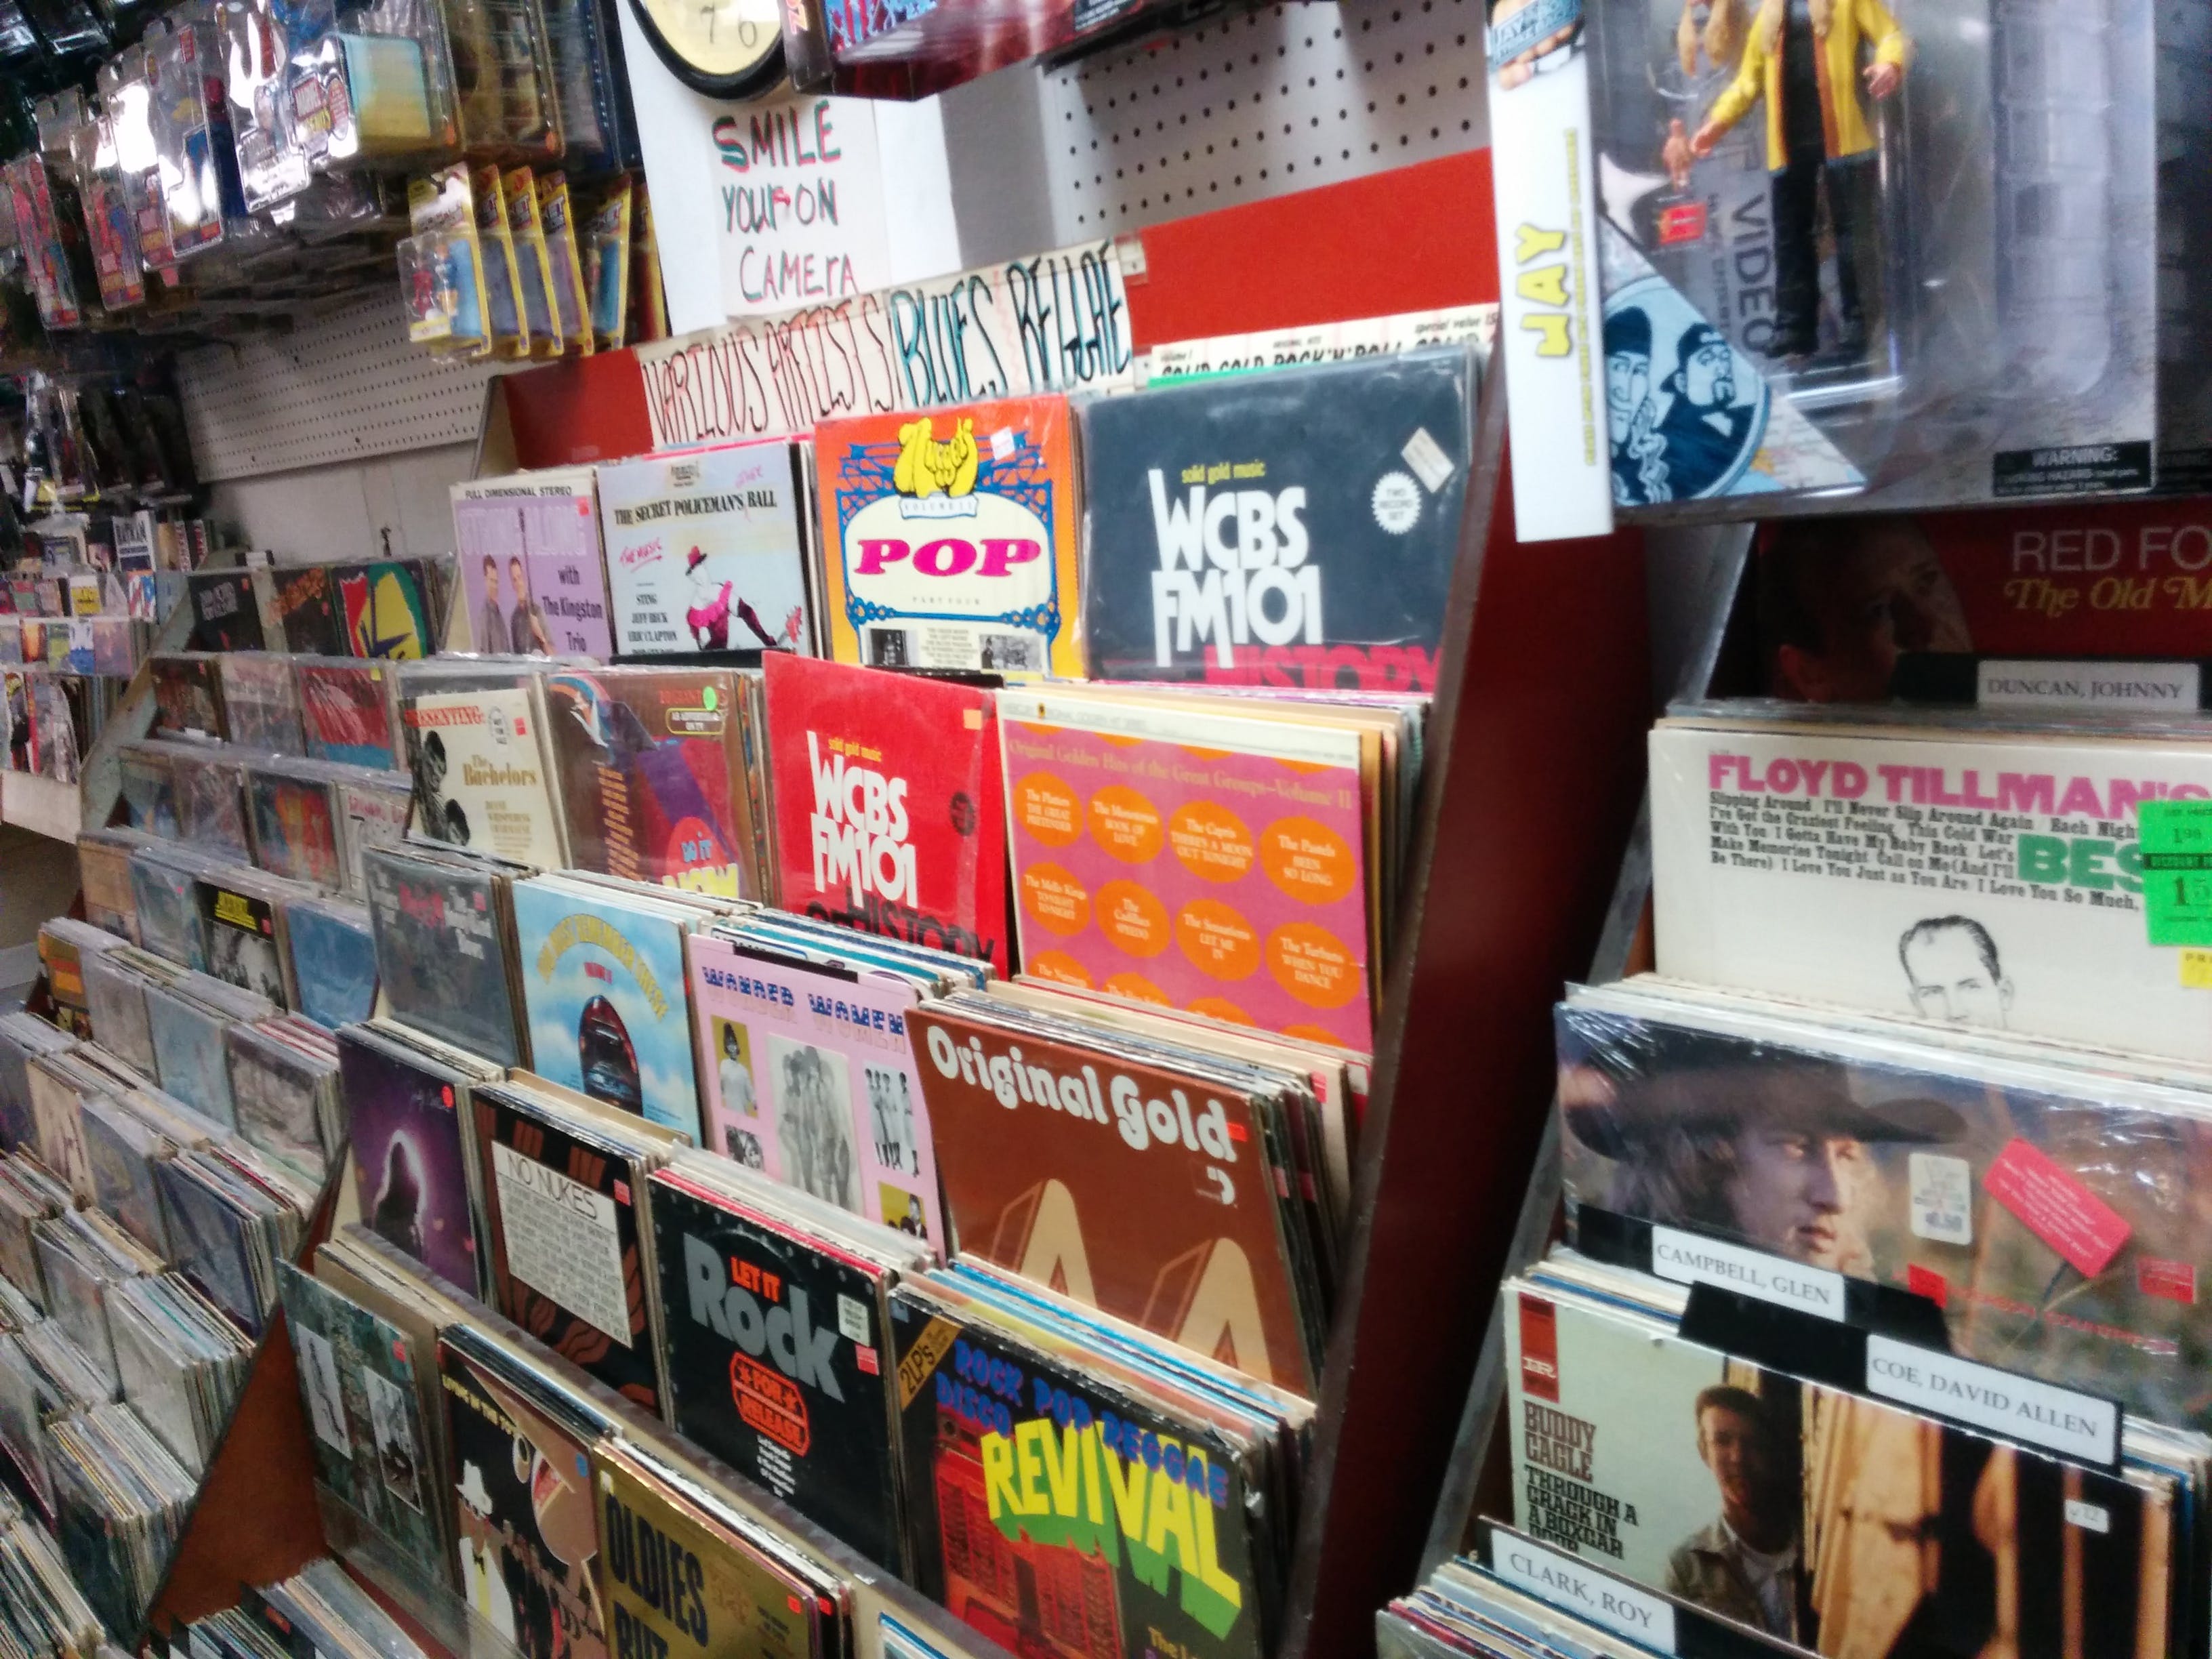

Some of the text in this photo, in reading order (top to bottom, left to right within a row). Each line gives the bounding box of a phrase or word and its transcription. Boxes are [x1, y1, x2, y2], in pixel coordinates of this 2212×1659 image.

[712, 99, 841, 173] SMILE
[796, 177, 839, 226] ON
[1515, 223, 1572, 359] JAY
[642, 332, 770, 441] VARIOUS
[763, 294, 895, 428] ARTISTS
[891, 274, 1008, 408] BLUES
[485, 486, 536, 499] DIMENSIONAL
[539, 485, 572, 497] STEREO
[1208, 463, 1231, 485] gold
[1233, 459, 1266, 479] music
[614, 489, 778, 526] THE SECRET POLICEMAN'S BALL
[1148, 468, 1309, 573] WCBS
[854, 537, 1041, 577] POP
[2012, 527, 2121, 572] RED
[558, 565, 581, 585] with
[2003, 577, 2079, 619] The
[2091, 576, 2155, 611] Old
[542, 595, 603, 622] The Kingston
[632, 612, 669, 623] JEFF BECK
[636, 593, 658, 606] STING
[565, 630, 588, 652] Trio
[644, 630, 678, 641] CLAPTON
[1987, 678, 2185, 701] DUNCAN, JOHNNY
[462, 762, 537, 787] Bachelors
[1010, 738, 1054, 760] Original
[1057, 747, 1099, 768] Golden
[1147, 759, 1170, 779] the
[1708, 754, 1869, 800] FLOYD
[806, 730, 909, 842] WCBS
[1186, 817, 1204, 834] The
[1710, 805, 1732, 820] I've
[1736, 807, 1757, 822] Got
[1762, 811, 1782, 825] the
[1907, 821, 1939, 839] This
[1943, 825, 1977, 842] Cold
[1981, 828, 2015, 845] War
[1764, 795, 1811, 812] Around
[1849, 800, 1889, 817] Never
[1896, 804, 1923, 823] Slip
[1929, 808, 1984, 826] Around
[1990, 813, 2034, 831] Again
[2051, 817, 2089, 835] Each
[1277, 834, 1299, 851] The
[1711, 820, 2015, 863] With You Gotta Have My Baby Back Let's
[1711, 834, 1744, 851] Make
[1748, 838, 1811, 858] Memories
[1816, 845, 1868, 865] Tonight
[1877, 848, 1904, 868] Call
[1906, 857, 1925, 870] on
[2018, 832, 2147, 894] BES
[1711, 849, 1727, 864] Be
[1730, 852, 1774, 871] There)
[1792, 858, 1822, 875] Love
[1826, 861, 1852, 878] You
[1856, 865, 1886, 881] Just
[1910, 870, 1938, 887] You
[1942, 874, 1969, 890] Are
[1989, 879, 2027, 897] Love
[2030, 882, 2058, 902] You
[2063, 886, 2084, 904] So
[1183, 913, 1202, 928] The
[1279, 936, 1301, 954] The
[702, 966, 905, 1038] WONDER WOMEN
[927, 1025, 1237, 1163] Original Gold
[506, 1152, 598, 1221] NO NUKES
[730, 1256, 781, 1303] LET IT
[1657, 1244, 1832, 1305] CAMPBELL, GLEN
[683, 1231, 846, 1404] Rock
[752, 1368, 783, 1401] FOR
[899, 1345, 935, 1395] 2LP's
[935, 1372, 1012, 1439] DISCO
[1872, 1357, 2098, 1437] COE, DAVID ALLEN
[954, 1338, 1229, 1511] ROCK POP REGGAE
[1523, 1399, 1597, 1454] BUDDY
[1525, 1430, 1594, 1483] CAGLE
[980, 1418, 1242, 1612] REVIVAL
[1524, 1463, 1640, 1527] THROUGH A
[1527, 1483, 1618, 1538] CRACK IN
[1528, 1502, 1624, 1560] A BOXCAR
[605, 1492, 709, 1648] OLDIES
[1510, 1552, 1654, 1630] CLARK, ROY
